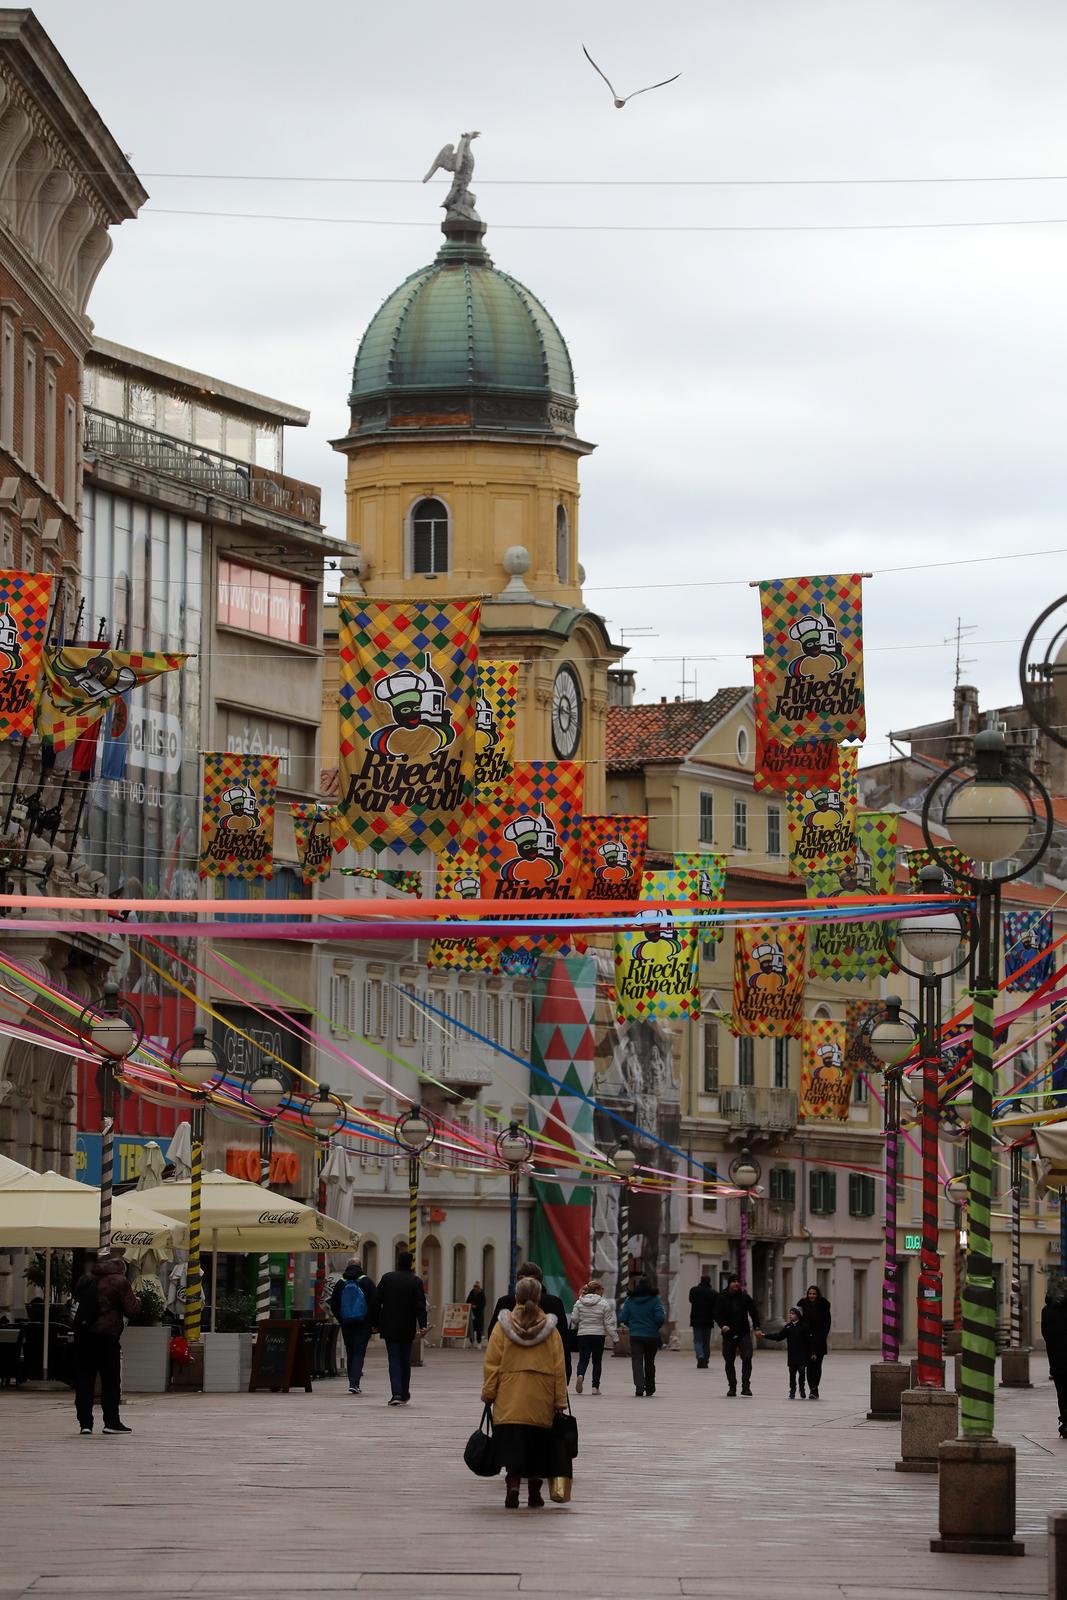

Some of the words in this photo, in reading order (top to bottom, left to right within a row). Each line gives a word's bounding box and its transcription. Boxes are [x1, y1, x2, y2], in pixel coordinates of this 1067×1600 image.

[783, 672, 857, 704] Riječki
[775, 688, 860, 721] karneval
[360, 748, 464, 793] Riječki
[346, 774, 466, 813] karneval
[207, 841, 272, 861] karneval
[214, 827, 267, 849] Riječki
[794, 833, 855, 859] karneval
[627, 956, 691, 984] Riječki
[621, 973, 693, 1000] karneval
[744, 986, 797, 1009] Riječki
[737, 1000, 798, 1021] karneval
